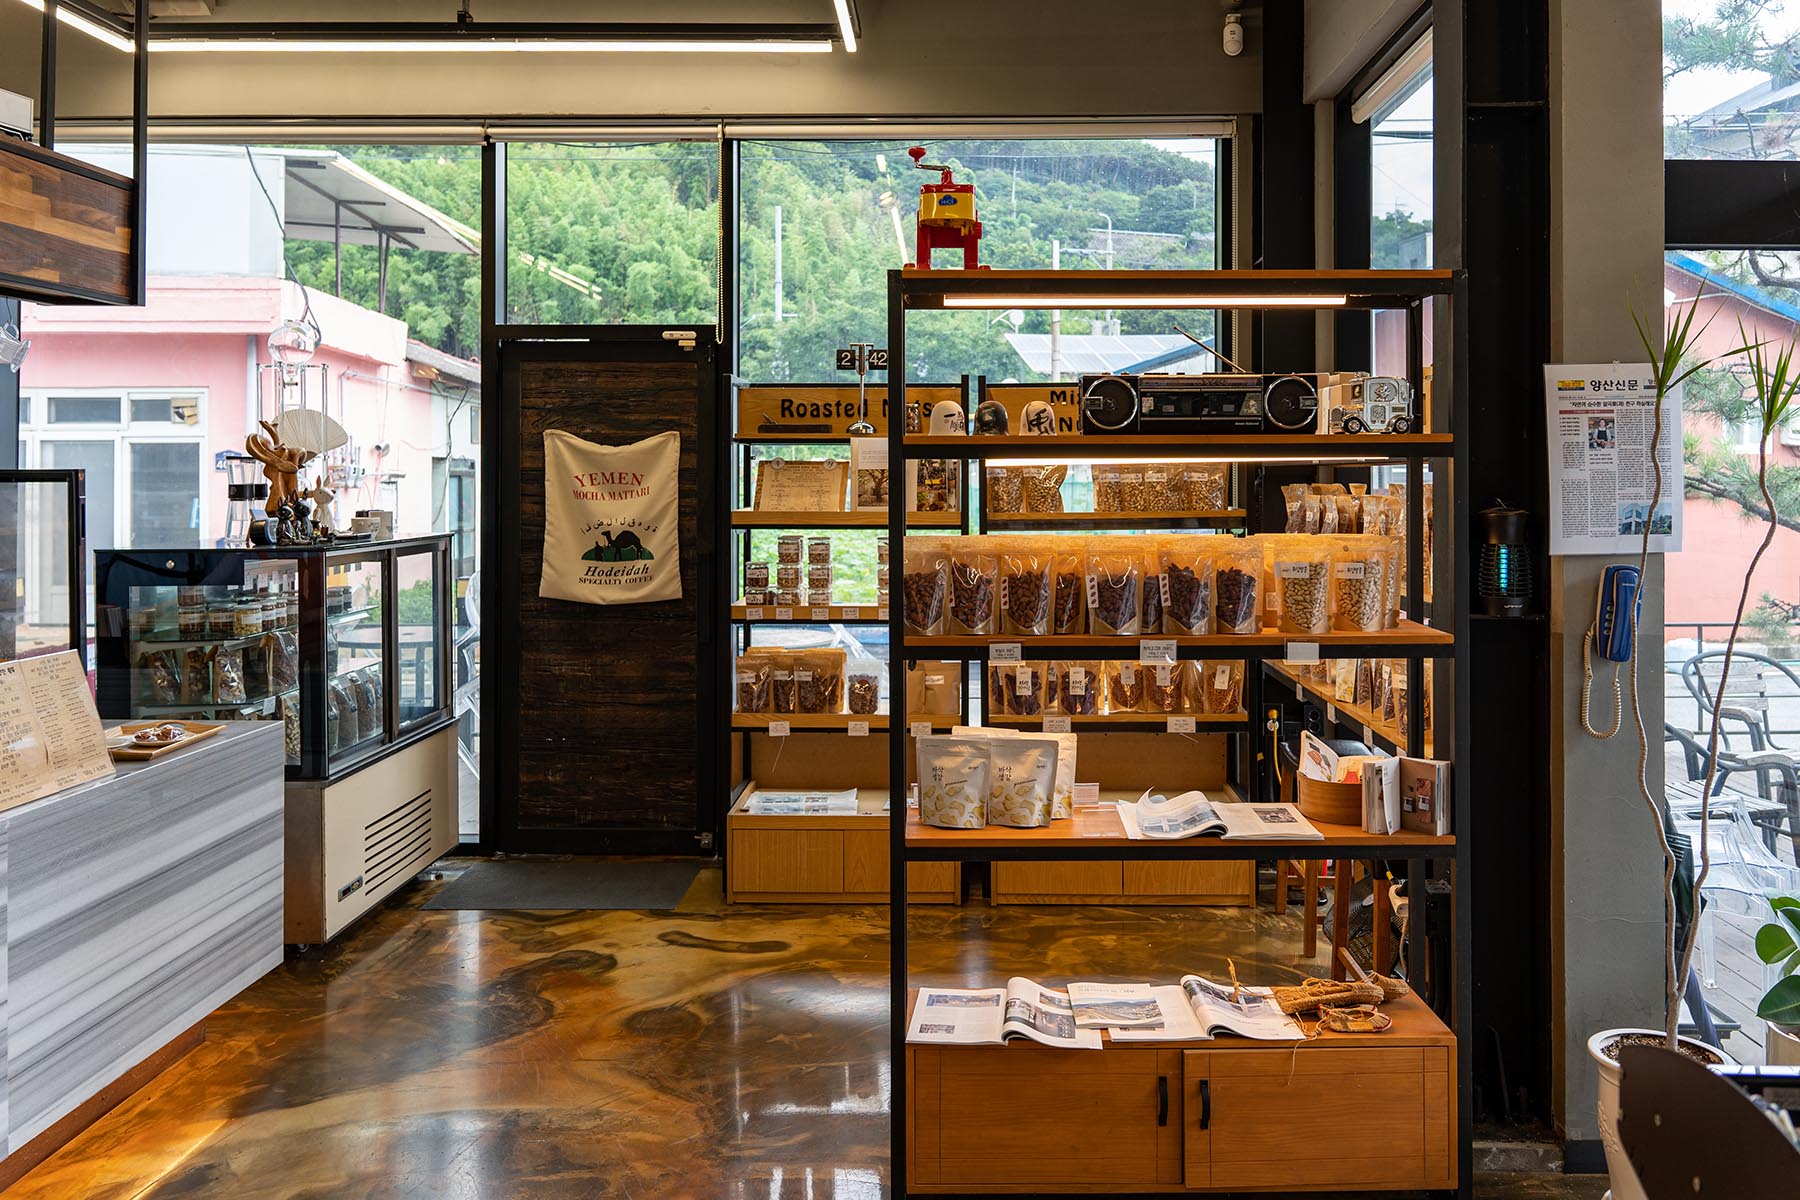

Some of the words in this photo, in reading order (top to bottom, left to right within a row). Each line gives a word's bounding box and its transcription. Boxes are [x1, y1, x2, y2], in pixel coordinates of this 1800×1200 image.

[841, 352, 851, 366] 2
[870, 352, 888, 366] 42
[1590, 379, 1639, 392] 양산신문
[781, 399, 869, 418] Roasted
[574, 471, 645, 488] YEMEN
[572, 489, 606, 501] MOCHA
[608, 486, 650, 501] MATTARI
[584, 563, 649, 577] Hodeidah
[578, 577, 622, 585] SPECIALTY
[625, 576, 653, 584] COFFEE
